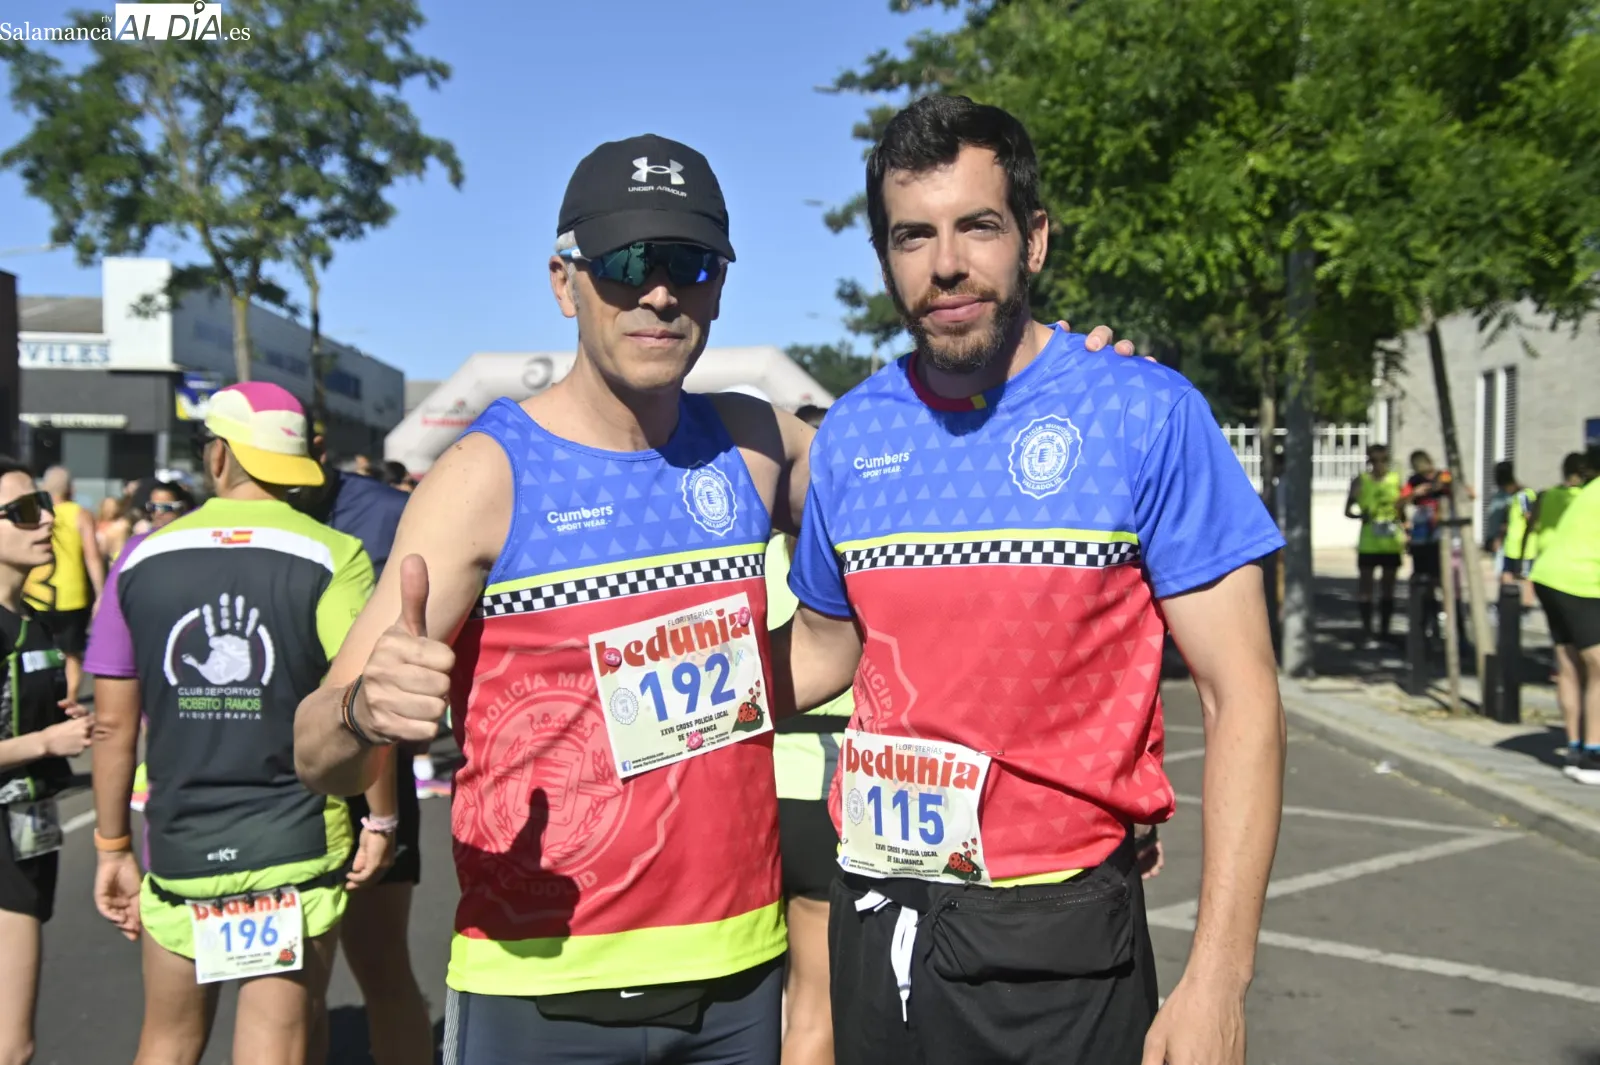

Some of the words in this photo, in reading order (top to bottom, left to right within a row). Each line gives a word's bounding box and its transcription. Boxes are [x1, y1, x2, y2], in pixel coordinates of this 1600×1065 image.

[656, 185, 687, 198] ARMOUR
[853, 452, 910, 470] Cumbers
[862, 469, 882, 479] SPORT
[1022, 477, 1063, 490] VALLADOLID
[547, 505, 614, 524] Cumbers
[556, 523, 582, 532] SPORT
[667, 608, 714, 627] FLORISTERÍAS
[178, 687, 203, 696] CLUB
[205, 687, 262, 697] DEPORTIVO
[639, 653, 736, 722] 192
[178, 698, 221, 711] ROBERTO
[224, 698, 261, 711] RAMOS
[477, 673, 549, 734] POLICÍA
[676, 721, 693, 732] CROSS
[714, 709, 729, 720] LOCAL
[678, 734, 686, 742] DE
[895, 743, 943, 754] FLORISTERÍAS
[845, 738, 981, 791] bedunia
[867, 785, 945, 846] 115
[887, 844, 901, 854] CROSS
[922, 850, 938, 858] LOCAL
[887, 855, 892, 863] DE
[893, 856, 924, 866] SALAMANCA
[220, 915, 279, 952] 196
